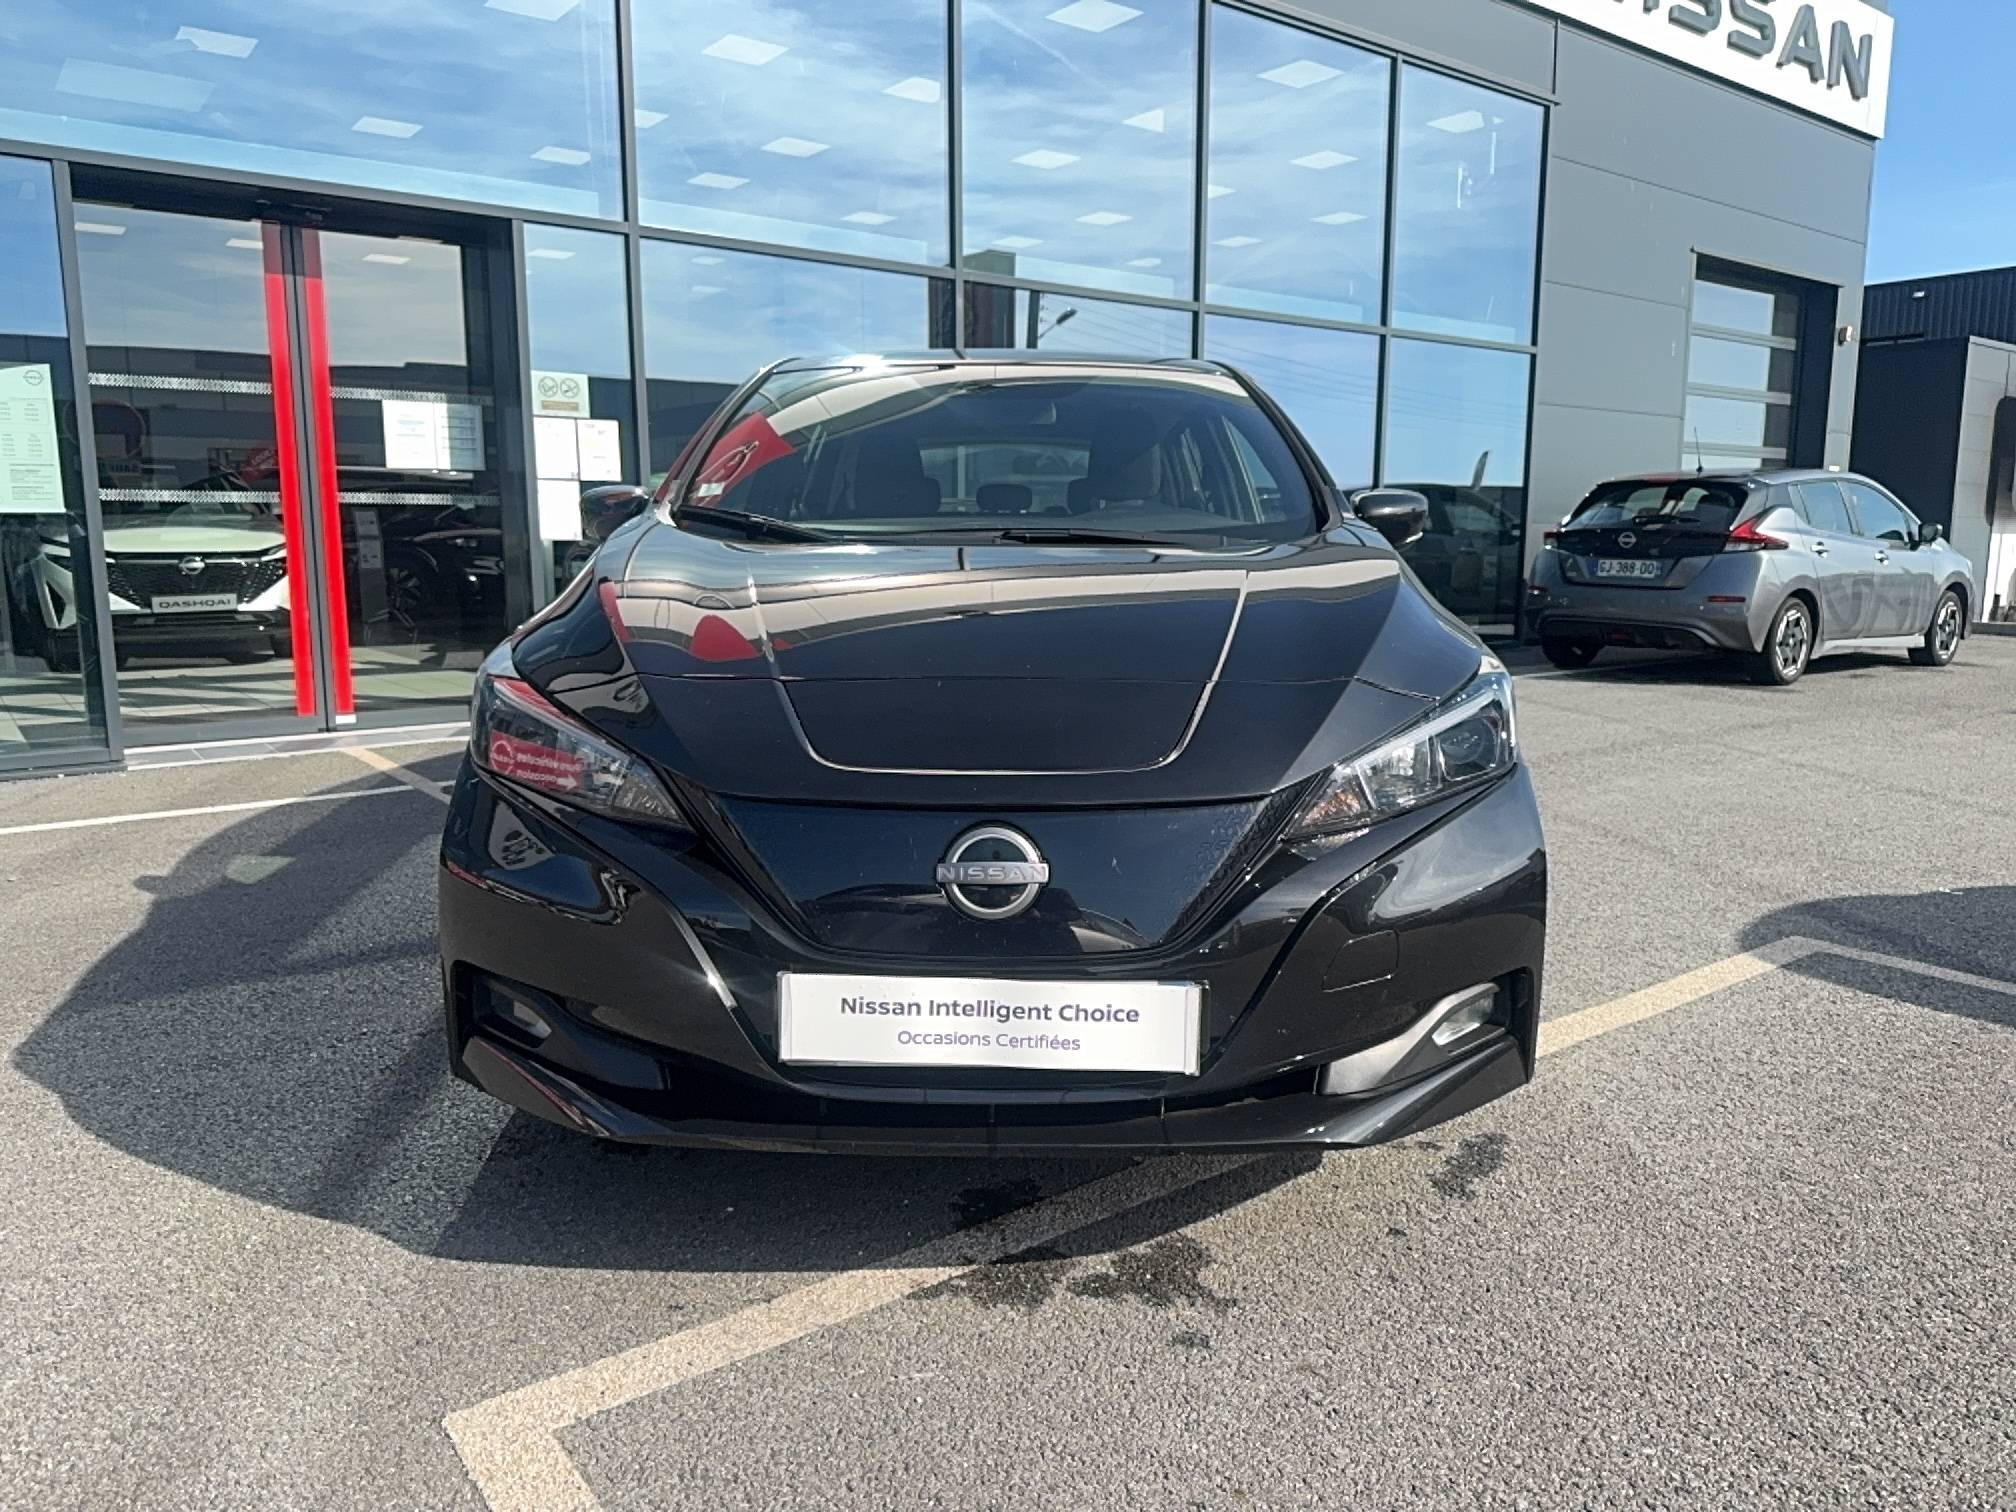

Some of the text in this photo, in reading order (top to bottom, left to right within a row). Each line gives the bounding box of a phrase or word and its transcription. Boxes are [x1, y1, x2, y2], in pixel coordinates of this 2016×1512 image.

[1614, 0, 1873, 101] SSAN
[159, 599, 231, 609] QASHQAI
[938, 866, 1048, 882] NISSAN
[840, 997, 1140, 1023] Nissan Intelligent Choice
[897, 1030, 1081, 1051] Occasions Certifiées
